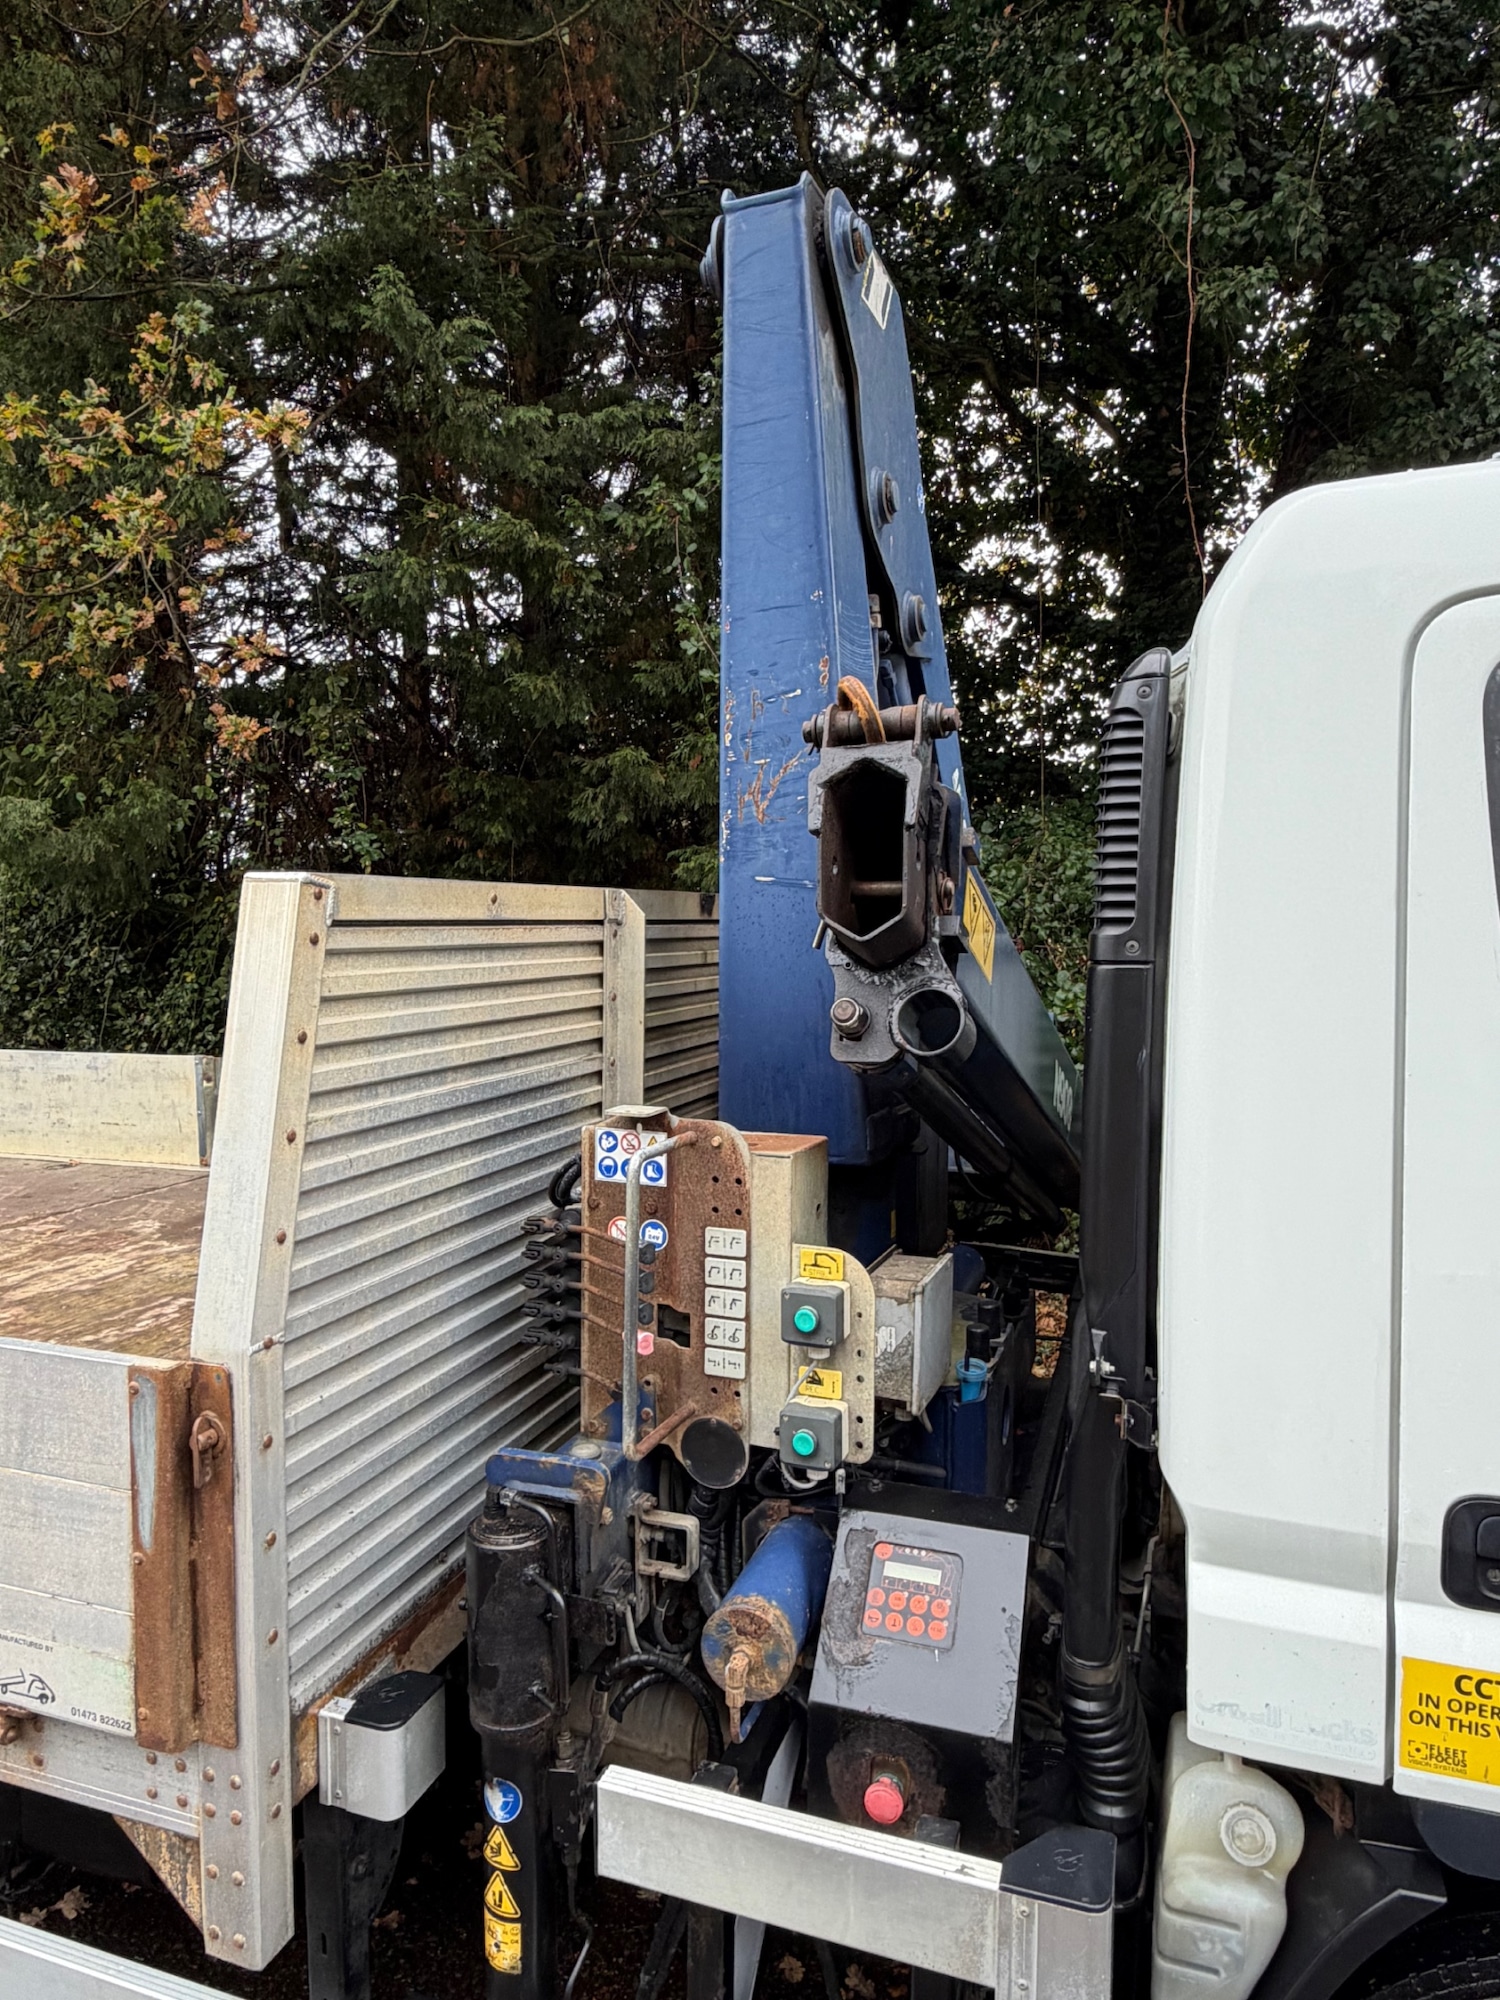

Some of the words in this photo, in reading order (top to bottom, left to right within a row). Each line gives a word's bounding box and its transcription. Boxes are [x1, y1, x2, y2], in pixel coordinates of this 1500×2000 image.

[1418, 1692, 1440, 1710] IN
[71, 1706, 97, 1722] 01473
[1408, 1709, 1440, 1729] ON
[1445, 1716, 1491, 1739] THIS
[1429, 1744, 1468, 1761] FLEET
[1429, 1752, 1468, 1768] FOCUS
[1433, 1763, 1467, 1775] SYSTEMS
